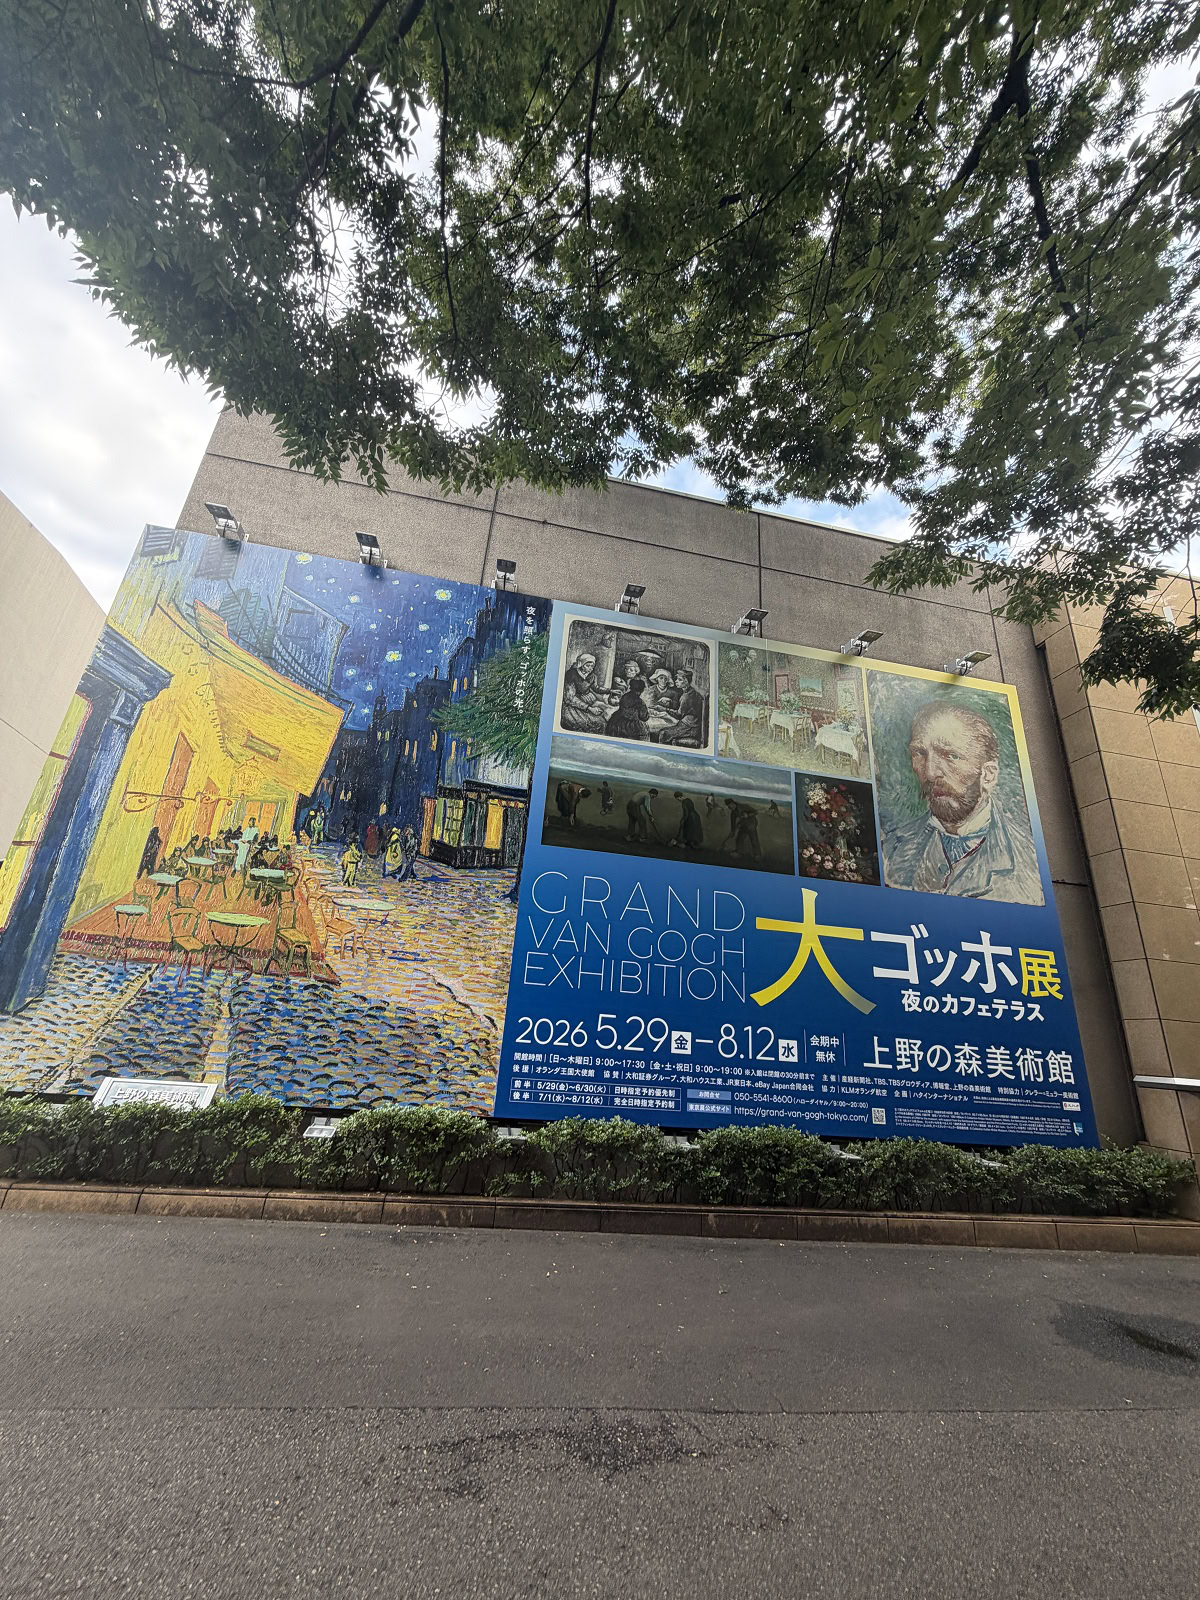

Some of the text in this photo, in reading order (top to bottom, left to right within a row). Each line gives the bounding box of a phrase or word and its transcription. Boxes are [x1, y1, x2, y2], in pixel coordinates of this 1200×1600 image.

[513, 606, 536, 714] 夜を照らす、ゴッホの光。
[531, 871, 746, 932] GRAND
[528, 915, 745, 968] VAN GOGH
[523, 951, 746, 1004] EXHIBITION
[901, 989, 1045, 1022] 夜のカフェテラス
[515, 1016, 588, 1048] 2026
[595, 1013, 669, 1052] 5.29
[717, 1023, 775, 1062] 8.12
[810, 1035, 840, 1048] 会期中
[815, 1051, 836, 1063] 無休
[863, 1036, 1076, 1085] 上野の森美術館
[733, 1106, 869, 1124] https://grand-van-gogh-tokyo.com/
